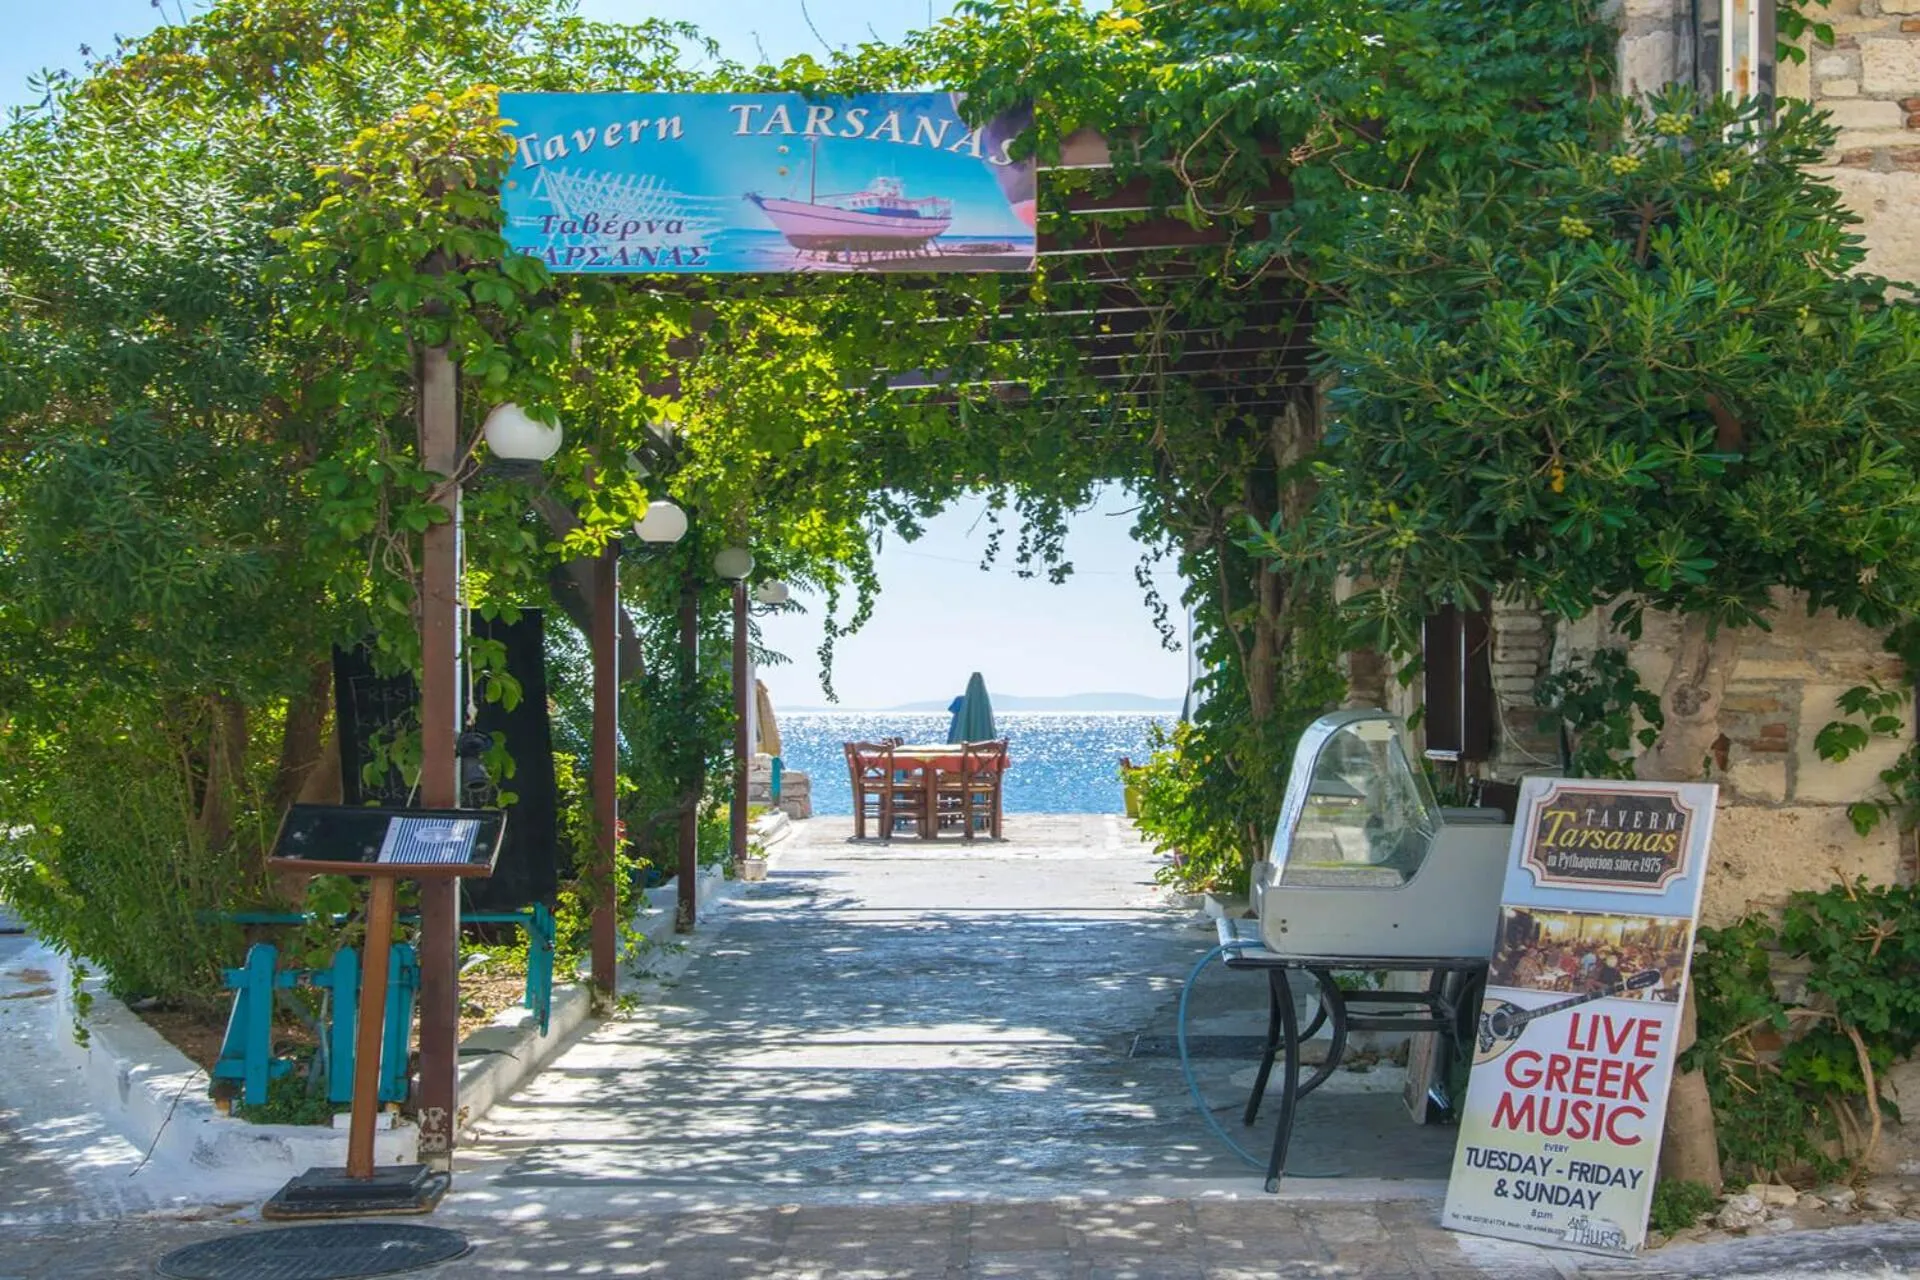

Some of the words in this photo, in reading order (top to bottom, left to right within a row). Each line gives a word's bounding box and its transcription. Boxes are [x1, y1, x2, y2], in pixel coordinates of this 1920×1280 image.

[517, 114, 684, 170] Tavern
[539, 212, 684, 241] Ταβέρνα
[1541, 810, 1677, 854] Tarsanas
[1586, 809, 1678, 831] TAVERN
[1558, 852, 1613, 870] Pythagorion
[1614, 856, 1640, 871] since
[1640, 857, 1663, 873] 1975
[1567, 1012, 1662, 1059] LIVE
[1504, 1050, 1655, 1103] GREEK
[1491, 1091, 1646, 1146] MUSIC
[1466, 1147, 1553, 1177] TUESDAY
[1568, 1160, 1643, 1190] FRIDAY
[1544, 1143, 1569, 1154] EVERY
[1494, 1178, 1509, 1198] &
[1513, 1182, 1602, 1211] SUNDAY
